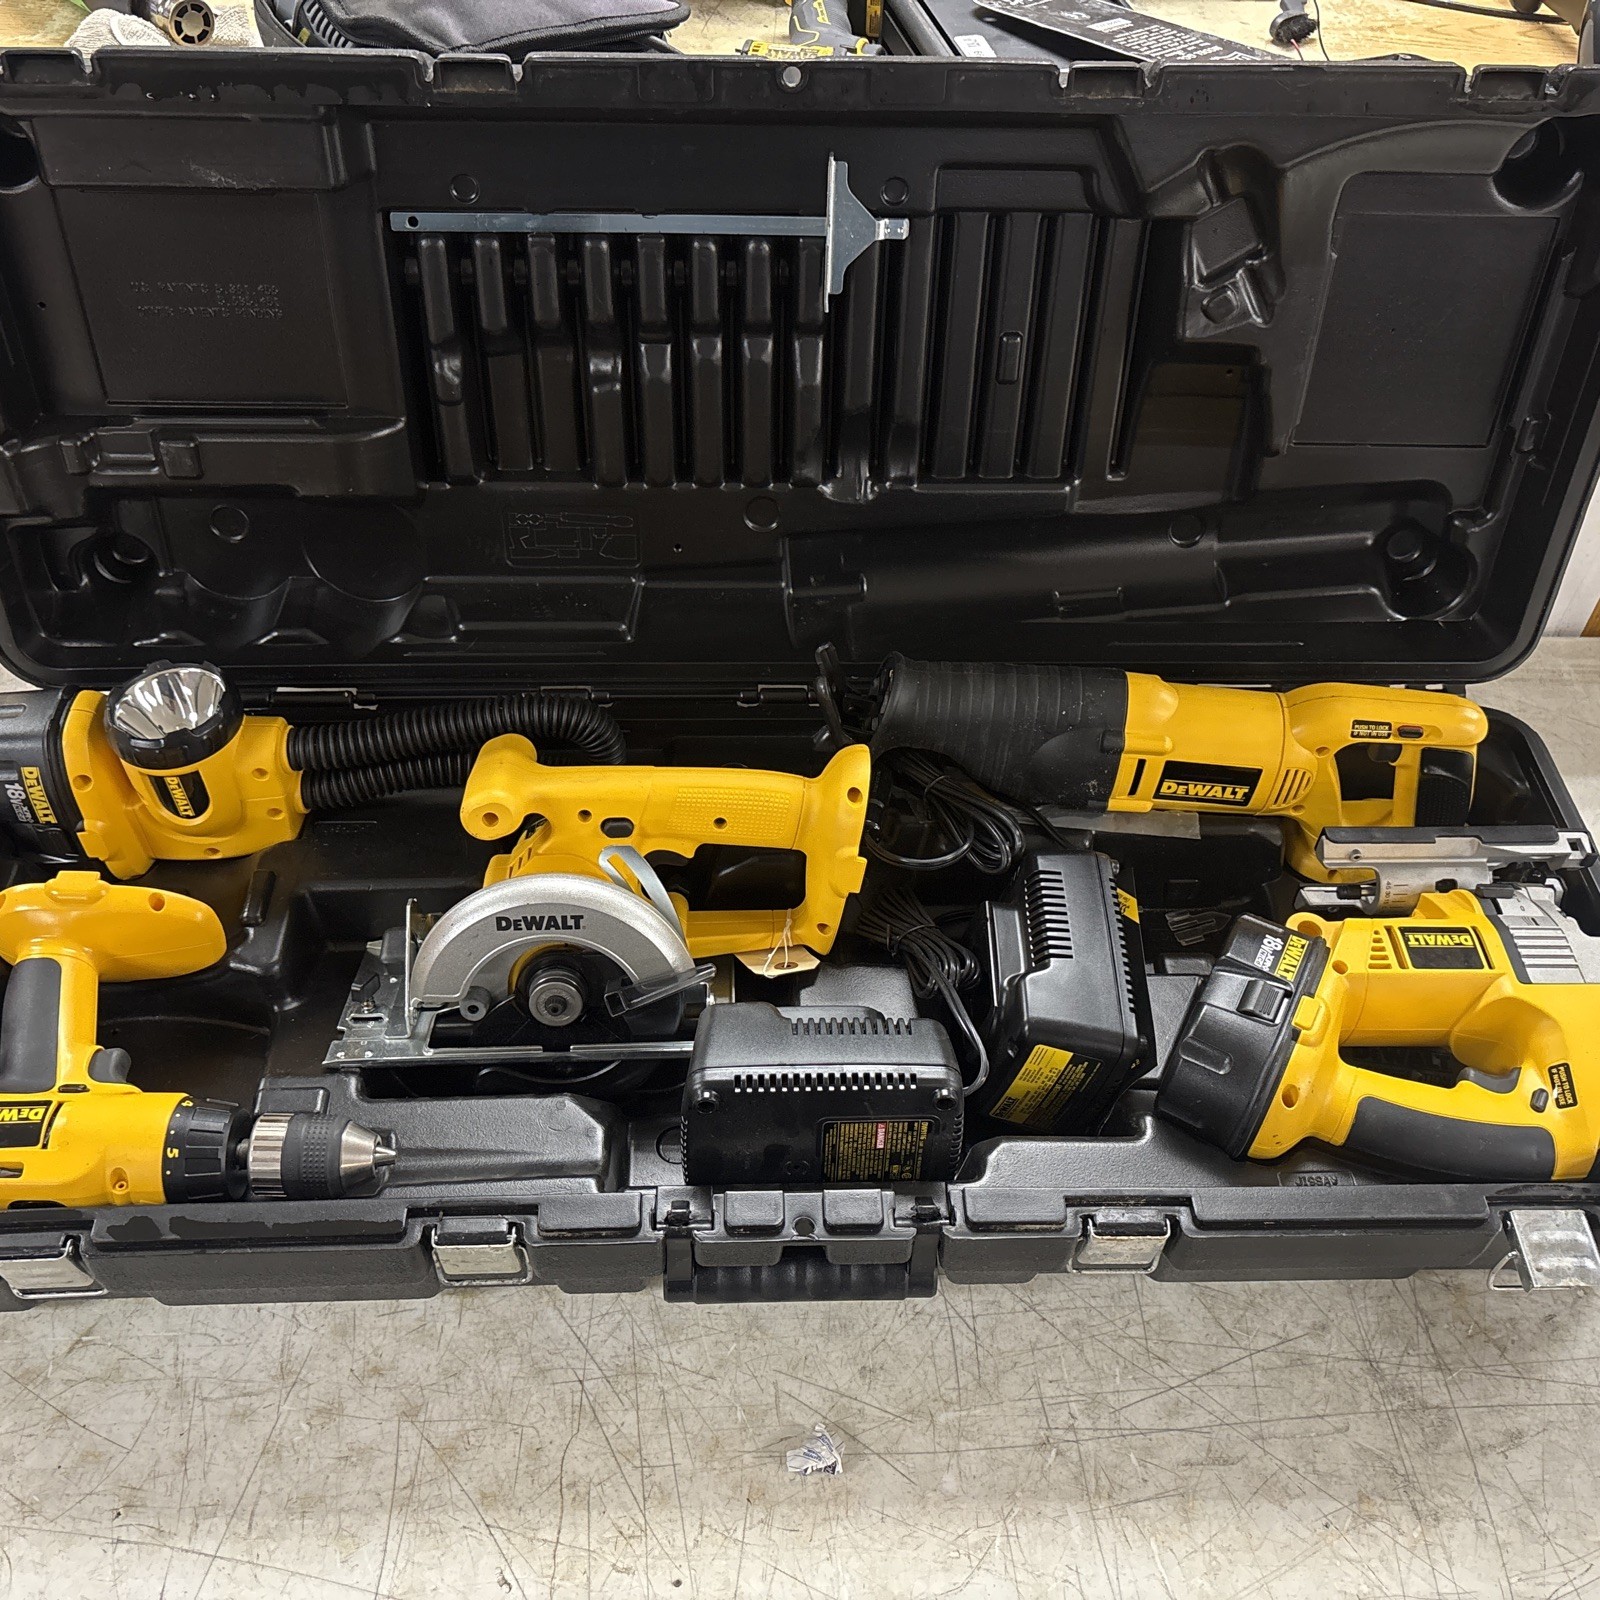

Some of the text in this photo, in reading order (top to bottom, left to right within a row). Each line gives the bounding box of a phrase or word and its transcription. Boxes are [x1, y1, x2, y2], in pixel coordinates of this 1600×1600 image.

[23, 767, 57, 824] DEWALT
[166, 776, 195, 817] DEWALT
[1160, 781, 1249, 800] DEWALT
[495, 914, 584, 931] DEWALT
[1408, 934, 1474, 946] DEWALT
[1277, 934, 1308, 982] DEWALT
[1553, 1074, 1561, 1086] NOT
[1558, 1094, 1566, 1105] USE
[1558, 1066, 1574, 1104] PUSH TO LOCK
[0, 1108, 46, 1121] DEW
[876, 1128, 885, 1149] DANGER
[166, 1147, 180, 1159] 5
